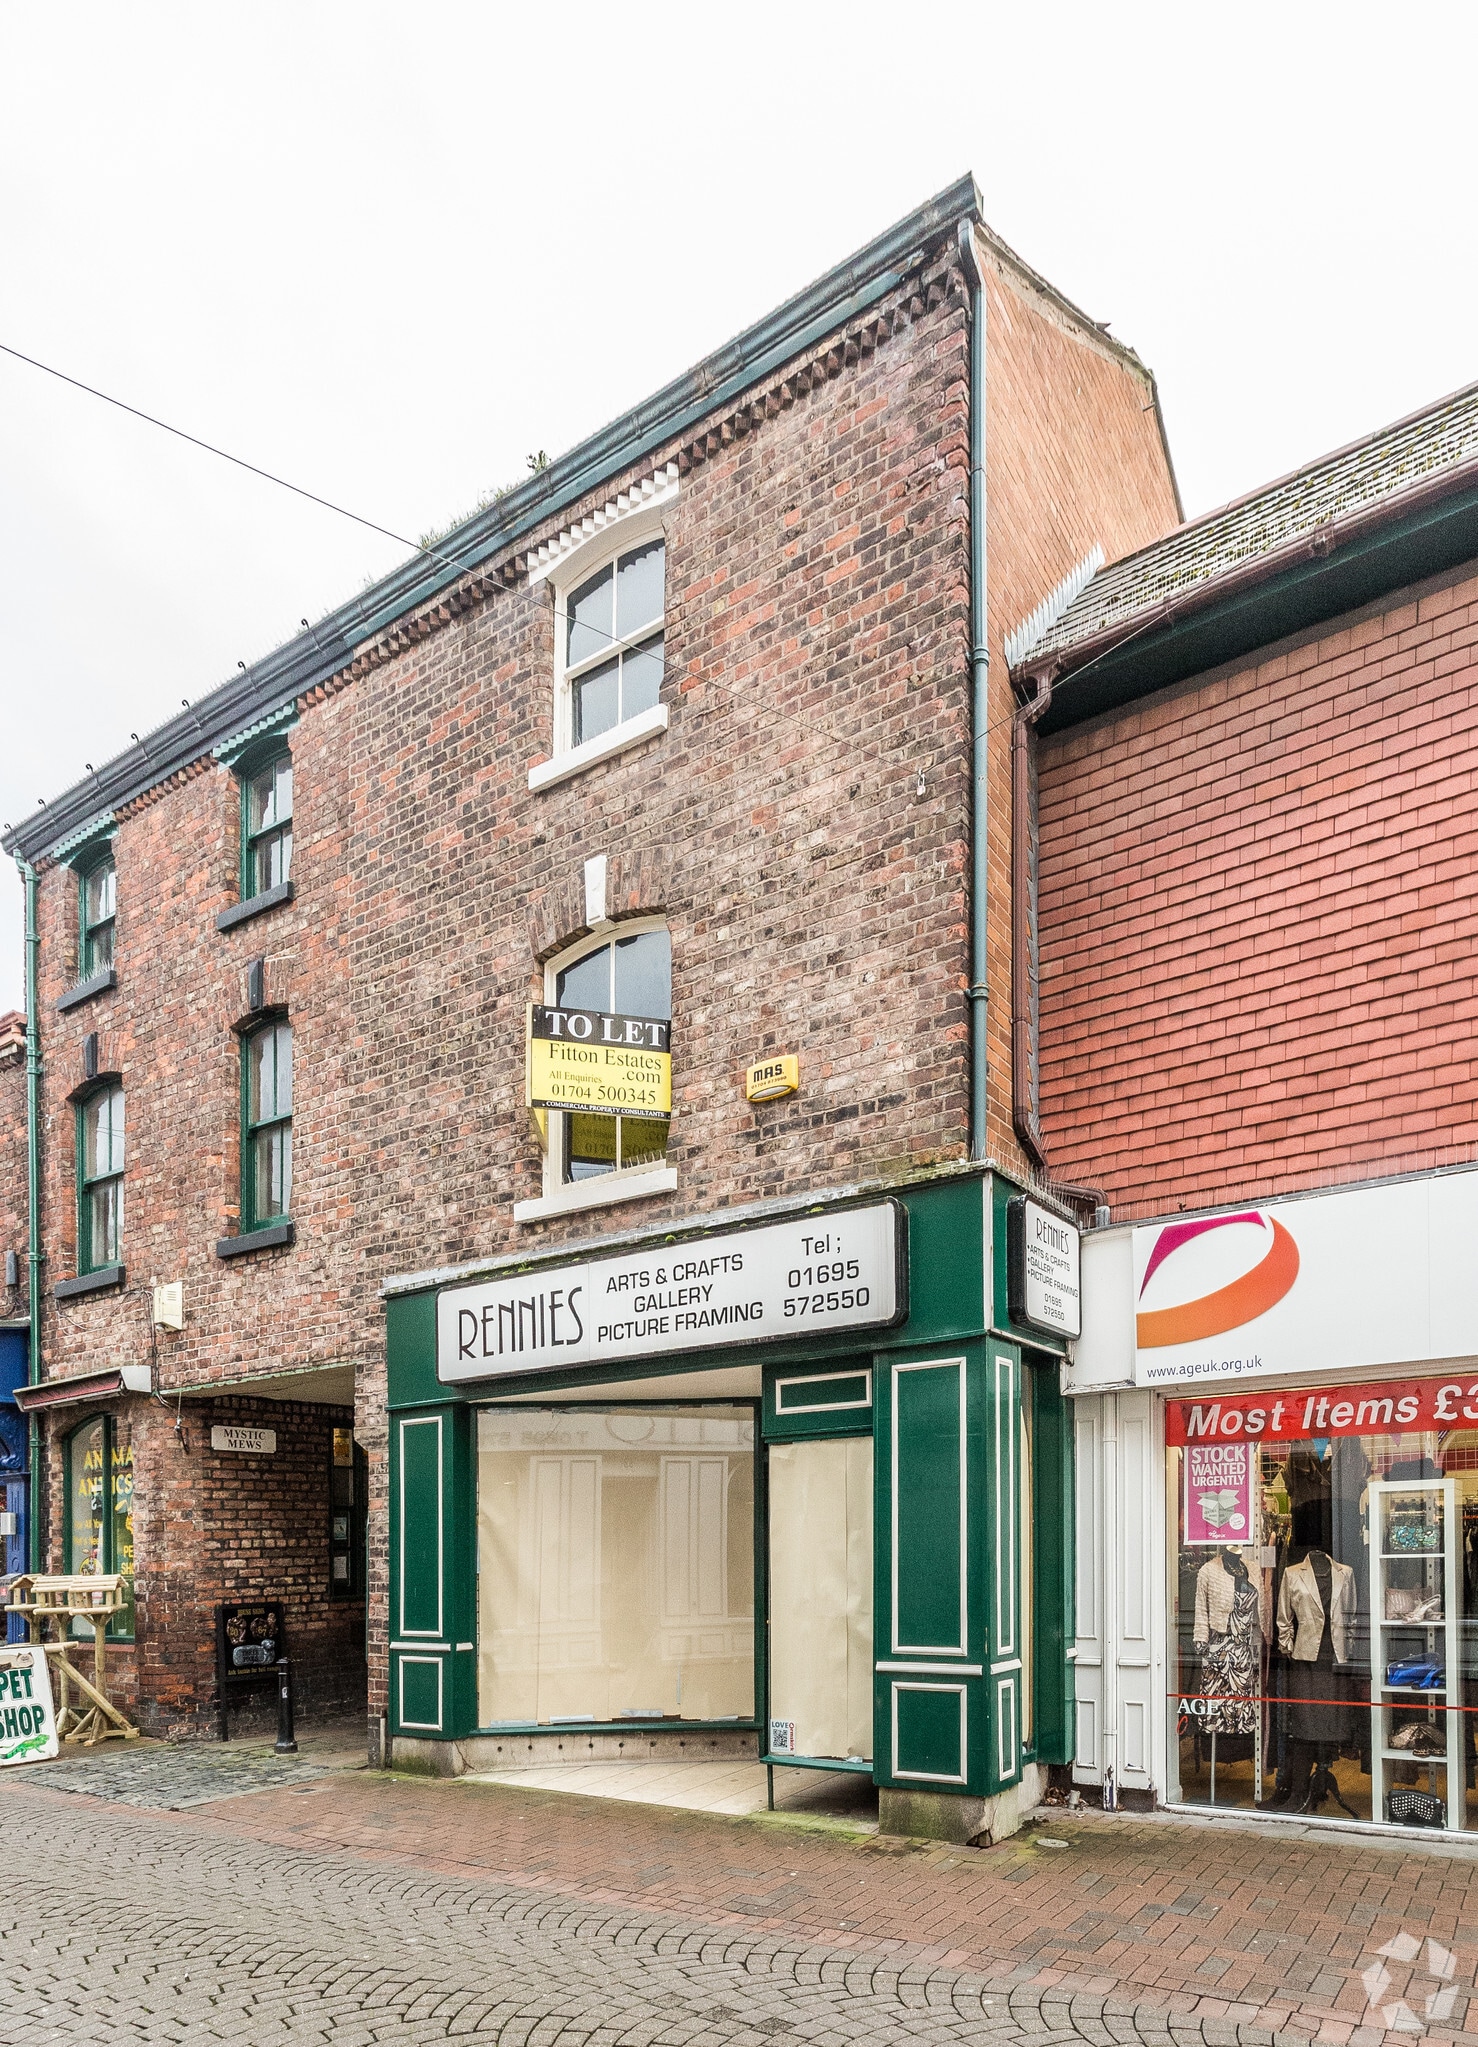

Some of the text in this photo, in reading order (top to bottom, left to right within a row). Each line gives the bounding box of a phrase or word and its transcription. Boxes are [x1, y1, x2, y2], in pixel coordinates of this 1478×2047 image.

[545, 1011, 666, 1047] TO LET
[549, 1043, 662, 1070] Fitton Estates
[549, 1070, 603, 1084] All Enquiries
[622, 1070, 661, 1084] .com
[551, 1084, 656, 1105] 01704 500345
[546, 1101, 589, 1111] COMMERCIAL
[589, 1104, 620, 1114] PROPERTY
[621, 1107, 665, 1118] CONSULTANTS
[1036, 1217, 1069, 1255] RENNIES
[1029, 1244, 1044, 1259] ARTS
[1050, 1254, 1071, 1272] CRAFTS
[1030, 1256, 1054, 1275] GALLERY
[606, 1253, 743, 1293] ARTS & CRAFTS
[788, 1259, 859, 1288] 01695
[1030, 1268, 1078, 1298] PICTURE FRAMING
[634, 1284, 713, 1313] GALLERY
[783, 1287, 870, 1317] 572550
[1044, 1293, 1062, 1308] 01695
[458, 1286, 583, 1361] RENNIES
[598, 1301, 763, 1342] PICTURE FRAMING
[1043, 1306, 1064, 1320] 572550
[1147, 1355, 1263, 1378] www.ageuk.org.uk
[1187, 1400, 1284, 1437] Most
[1302, 1396, 1418, 1430] Items
[223, 1428, 266, 1440] MYSTIC
[227, 1439, 262, 1449] MEWS
[1191, 1445, 1246, 1464] STOCK
[1191, 1462, 1246, 1476] WANTED
[1192, 1475, 1246, 1487] URGENTLY
[0, 1668, 33, 1701] PET
[1177, 1698, 1221, 1716] AGE
[771, 1721, 789, 1729] LOVE
